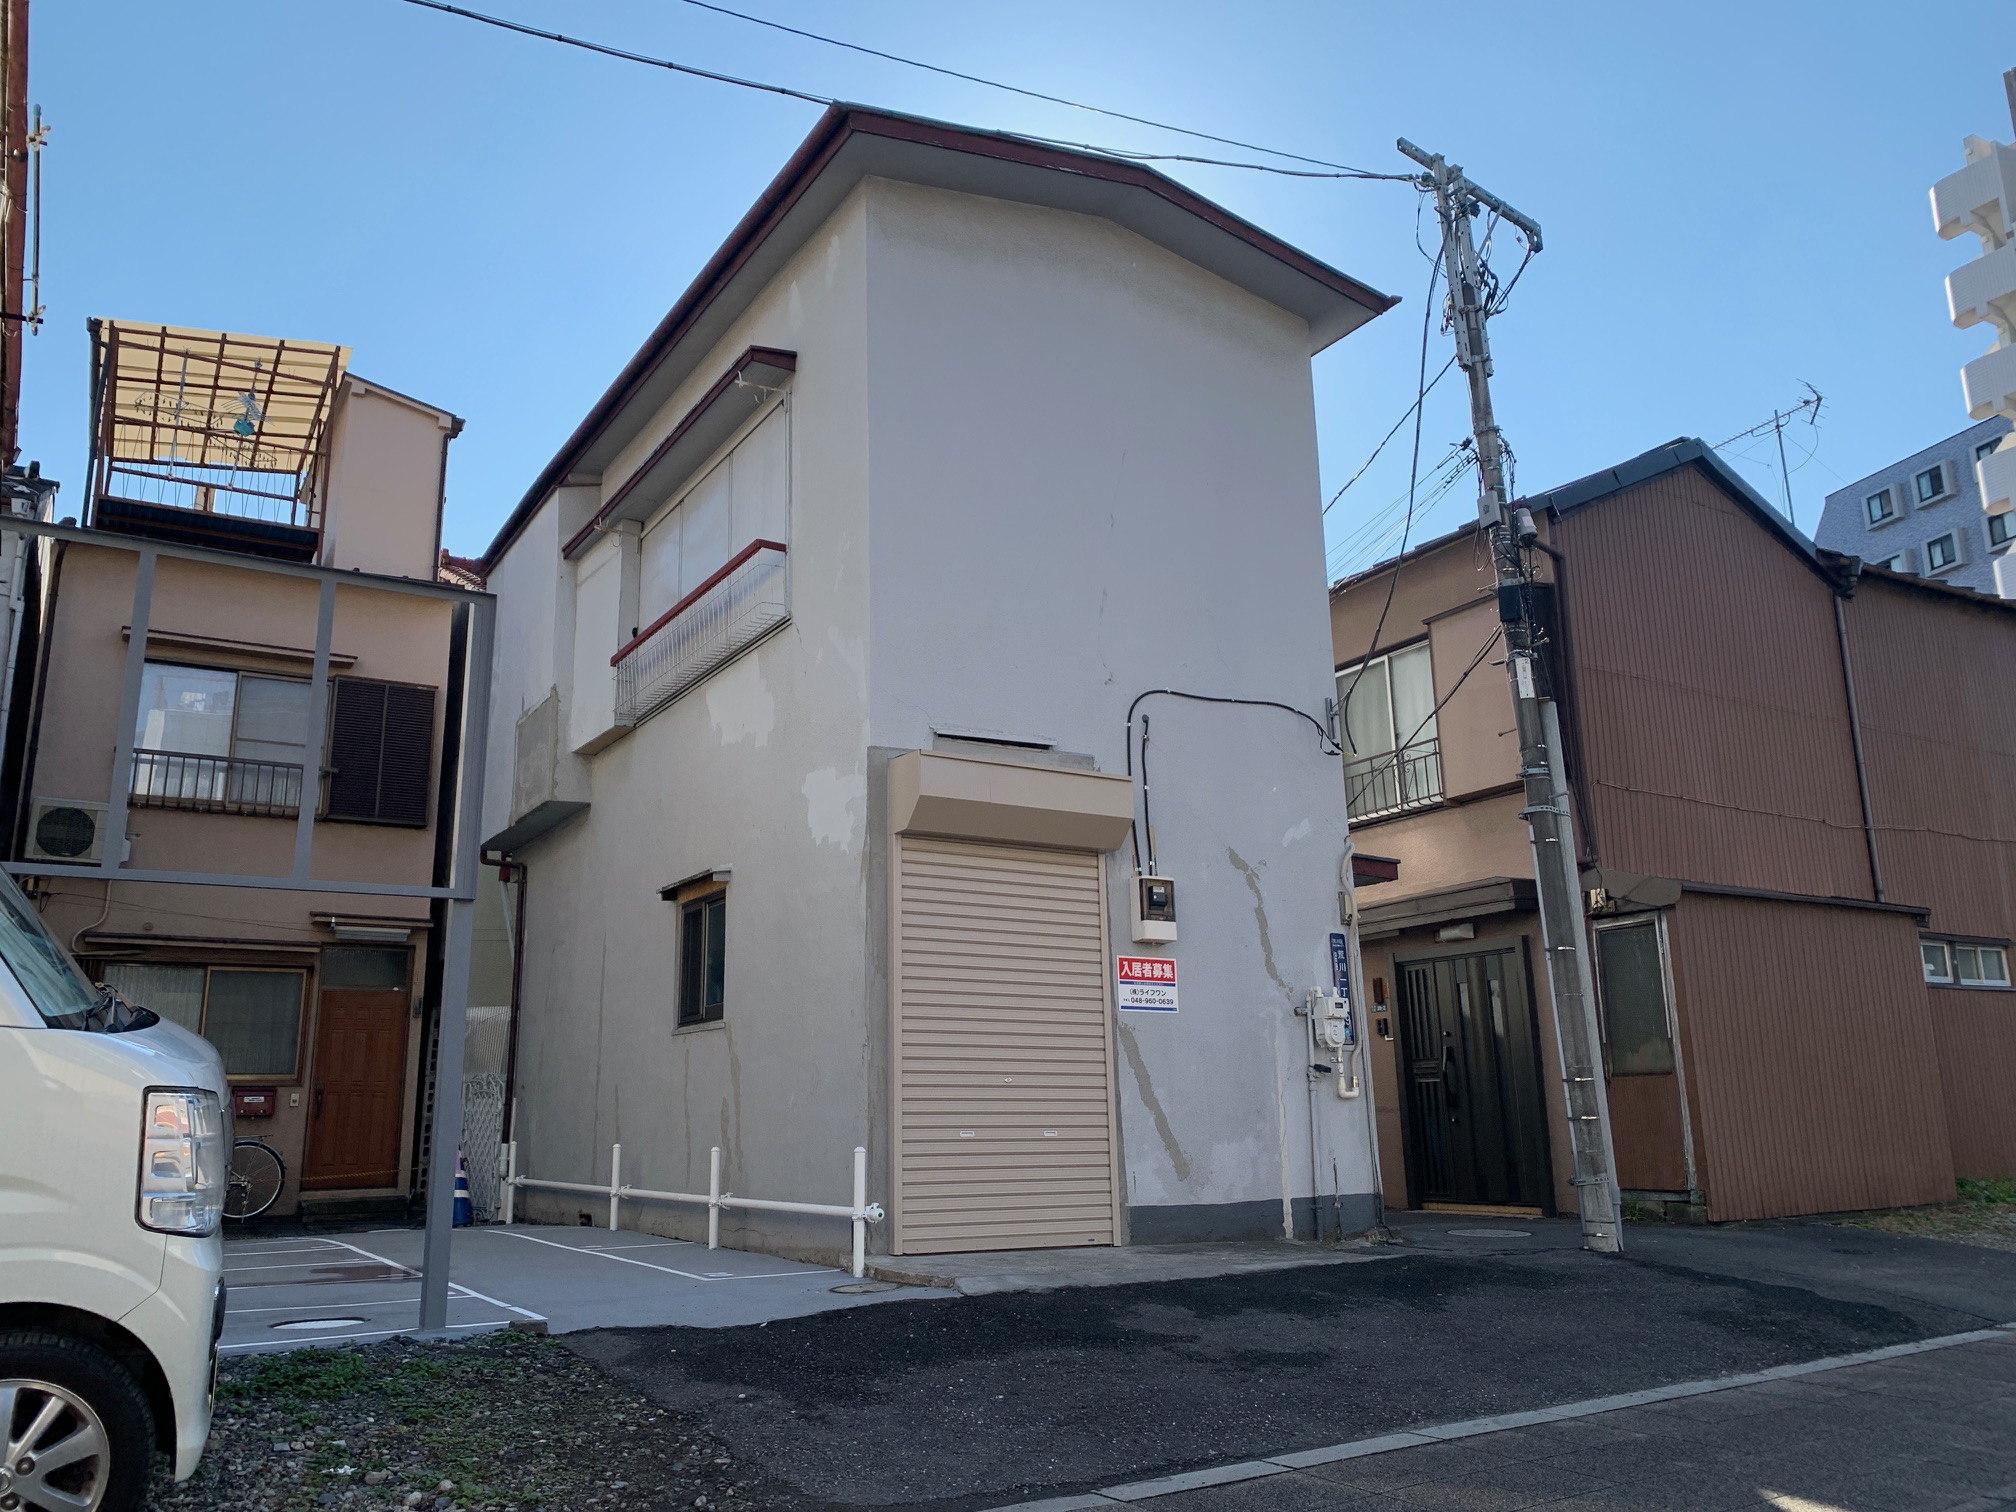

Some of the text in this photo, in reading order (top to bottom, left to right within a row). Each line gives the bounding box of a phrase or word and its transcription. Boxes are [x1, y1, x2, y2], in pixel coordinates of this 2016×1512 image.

[1121, 961, 1173, 978] 入居者募集
[1338, 950, 1347, 997] 荒川一丁
[1131, 997, 1173, 1005] 048-960-0639
